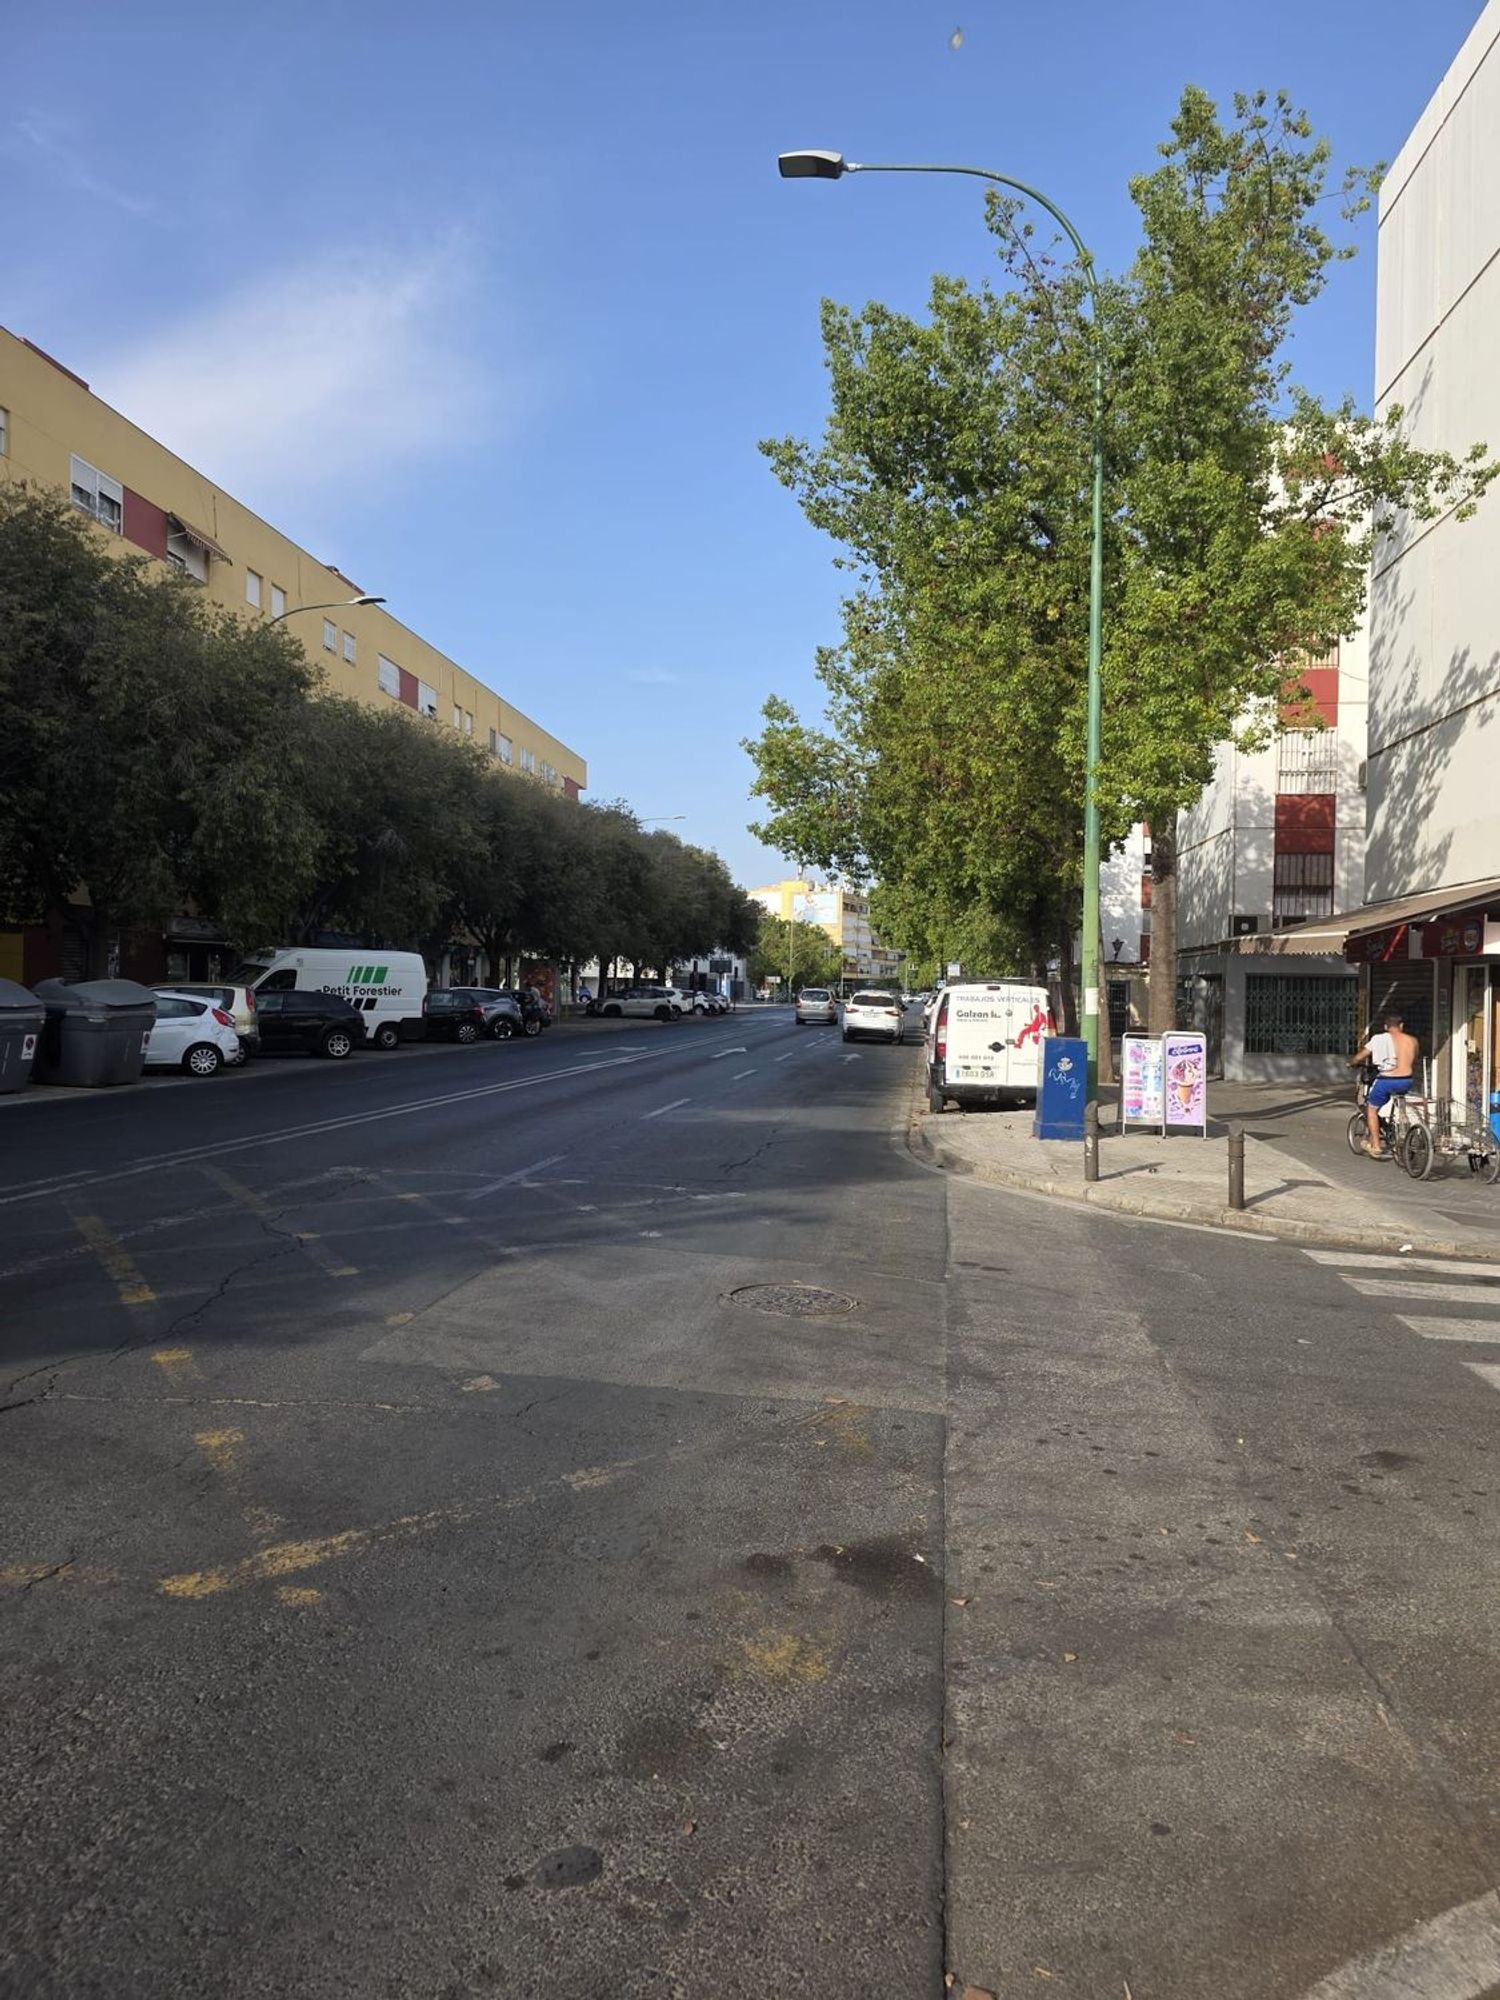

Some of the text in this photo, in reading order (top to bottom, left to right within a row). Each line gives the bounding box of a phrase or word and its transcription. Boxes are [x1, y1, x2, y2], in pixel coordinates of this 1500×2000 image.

[322, 985, 402, 996] Petit Forestier
[956, 995, 995, 1003] TRABAJOS
